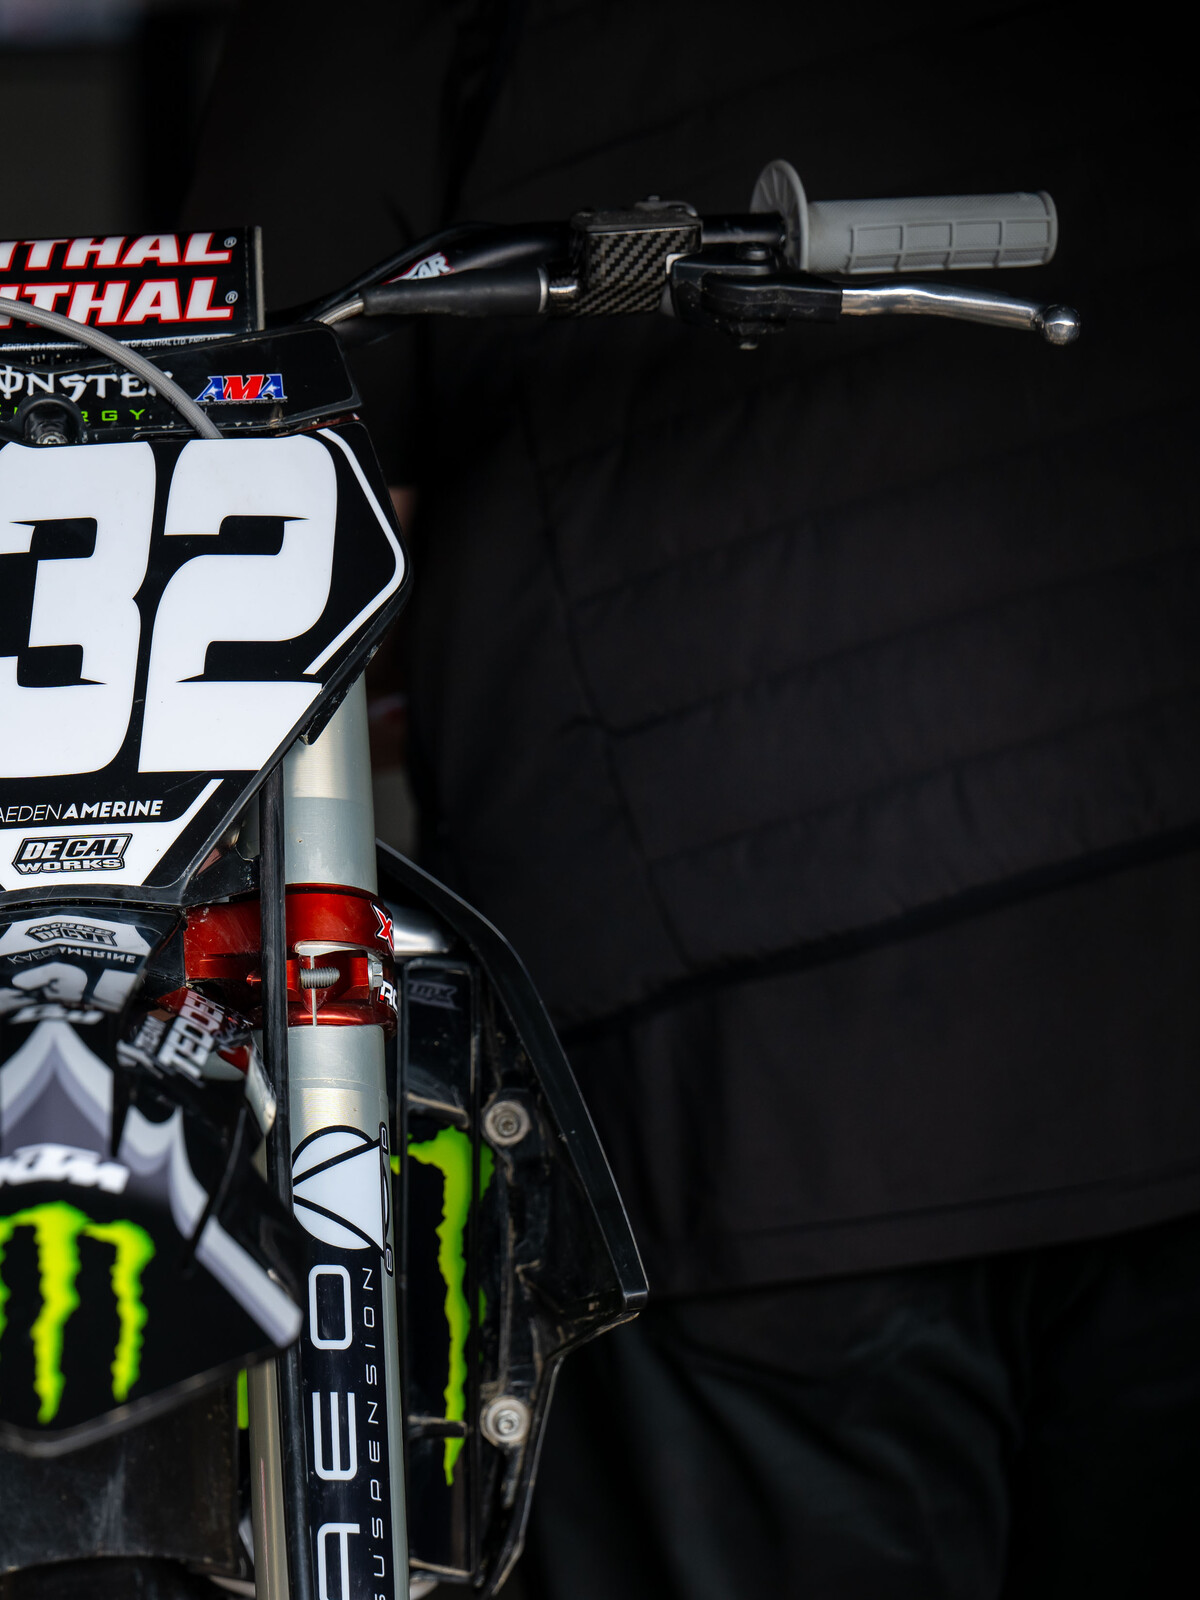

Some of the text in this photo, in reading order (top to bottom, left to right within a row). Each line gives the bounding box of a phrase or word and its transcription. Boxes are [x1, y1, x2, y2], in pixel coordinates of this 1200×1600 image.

[193, 373, 288, 402] AMA
[62, 799, 164, 820] AMERINE
[17, 858, 123, 874] WORKS
